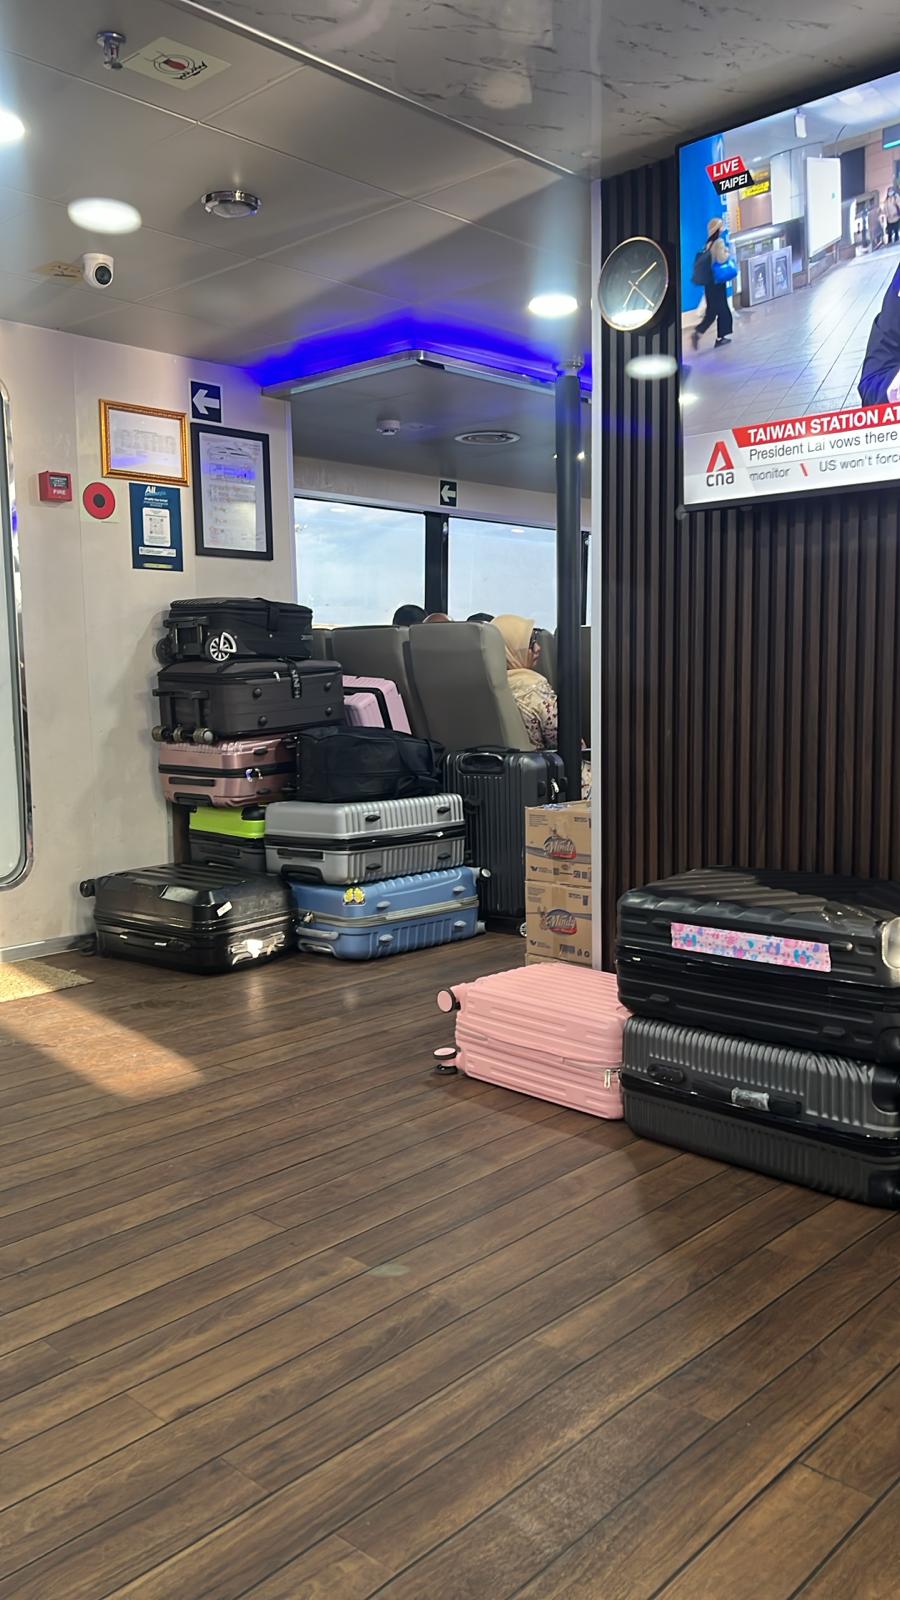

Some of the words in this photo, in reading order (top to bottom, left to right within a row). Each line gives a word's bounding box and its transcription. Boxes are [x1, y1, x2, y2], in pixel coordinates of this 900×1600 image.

[713, 159, 740, 178] LIVE
[719, 173, 748, 191] TAIPEI
[747, 421, 806, 444] TAIWAN
[810, 409, 879, 434] STATION
[749, 442, 804, 461] President
[807, 441, 825, 453] Lai
[829, 436, 861, 449] vows
[865, 430, 898, 445] there
[819, 460, 837, 472] US
[840, 456, 872, 470] won't
[876, 453, 900, 466] forc
[706, 471, 735, 487] cna
